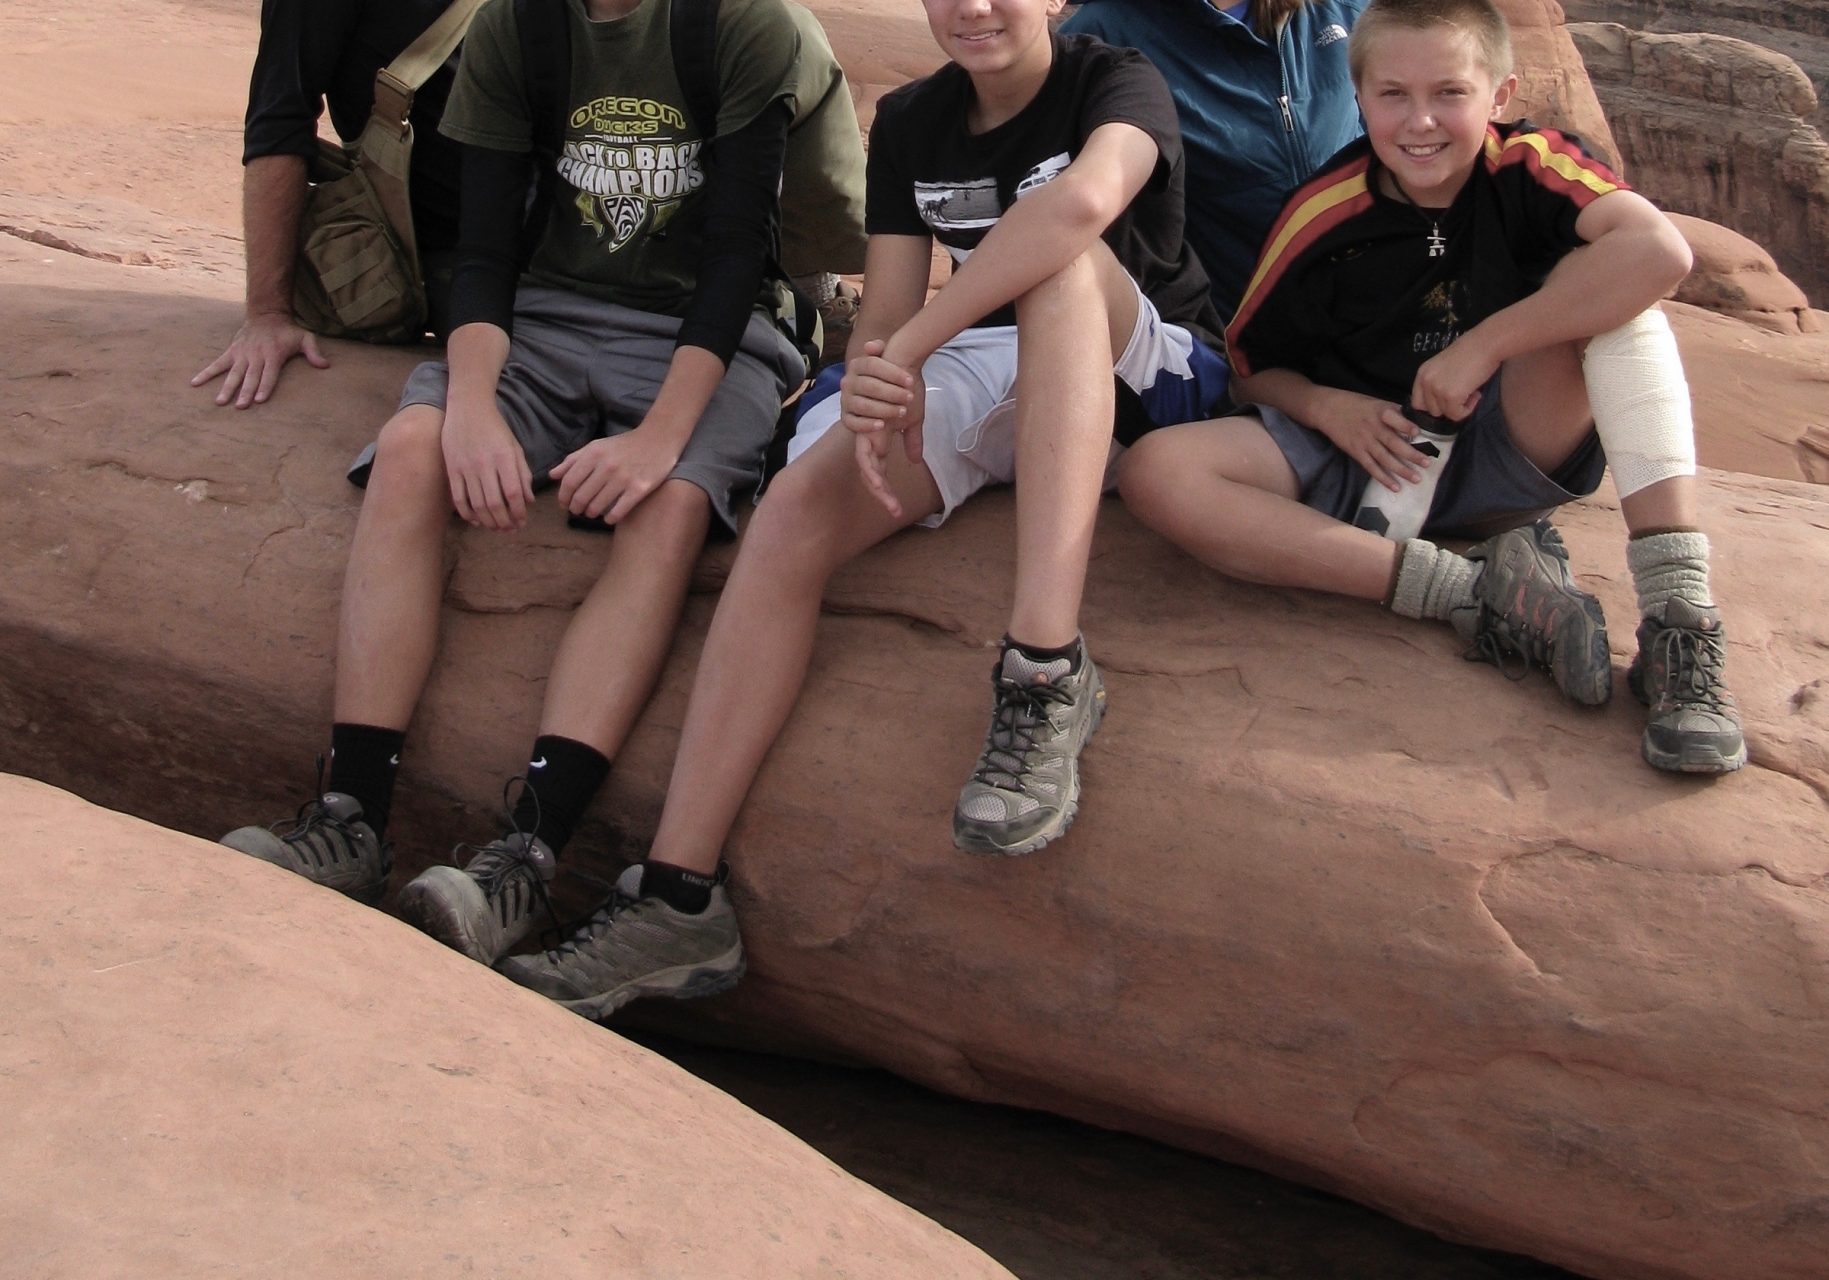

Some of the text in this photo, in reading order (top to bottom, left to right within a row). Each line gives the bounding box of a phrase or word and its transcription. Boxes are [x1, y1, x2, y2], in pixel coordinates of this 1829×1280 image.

[571, 96, 686, 129] OREGON
[594, 118, 658, 134] DUCKS
[563, 140, 605, 168] ACK
[606, 149, 630, 168] TO
[556, 156, 704, 198] CHAMPIONS
